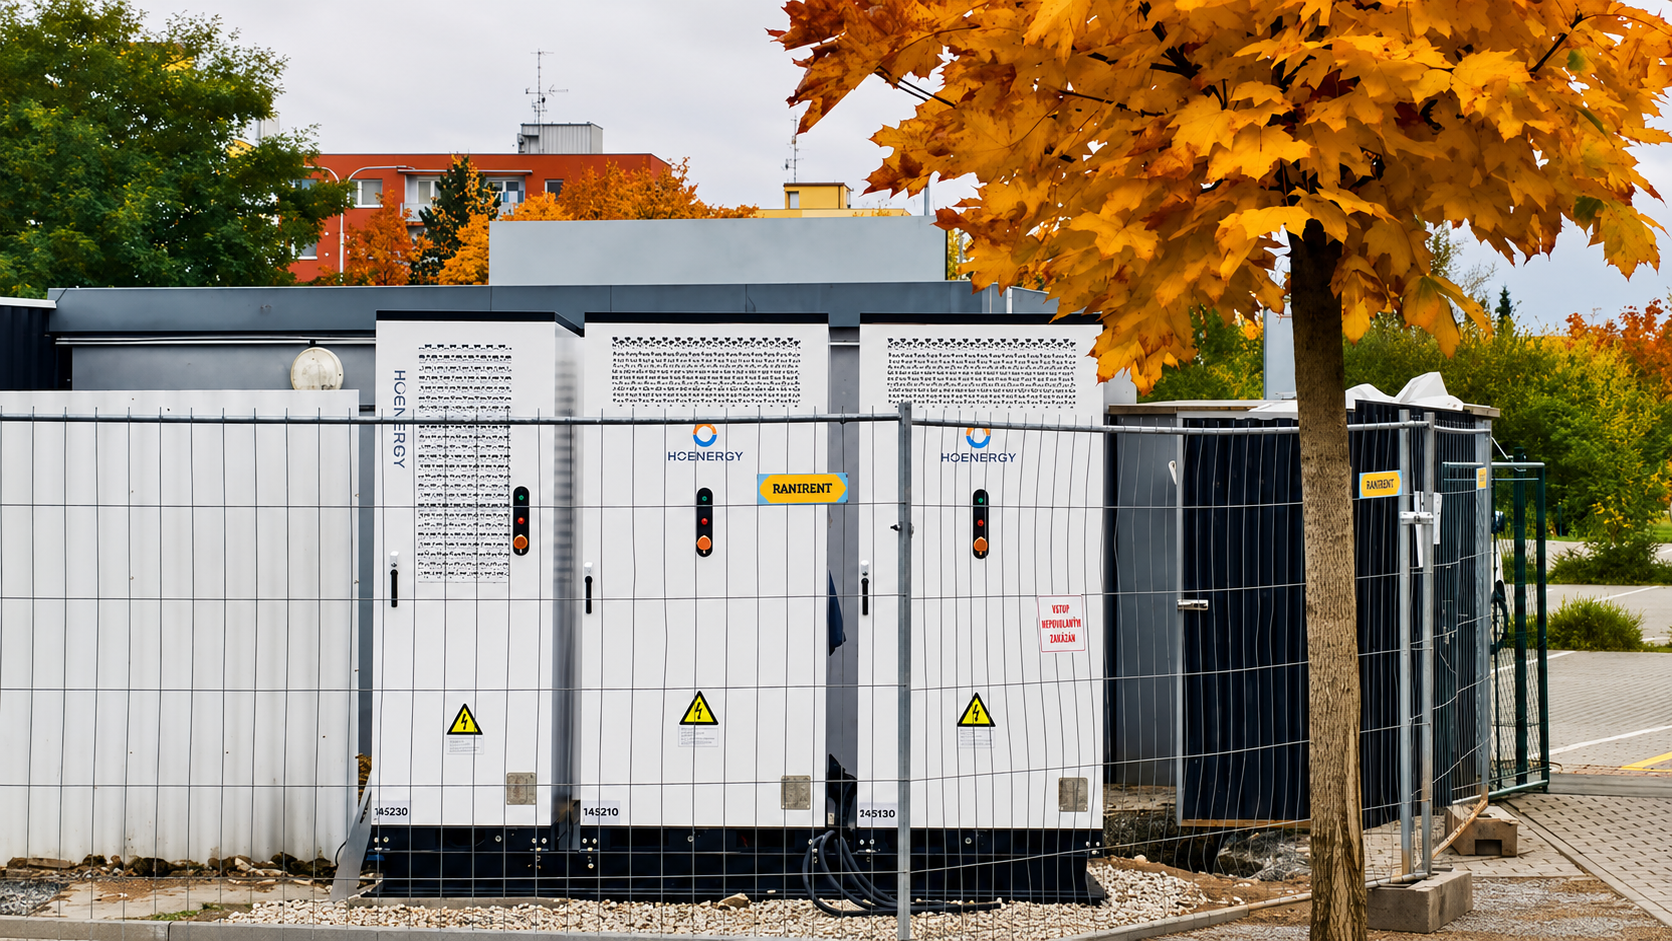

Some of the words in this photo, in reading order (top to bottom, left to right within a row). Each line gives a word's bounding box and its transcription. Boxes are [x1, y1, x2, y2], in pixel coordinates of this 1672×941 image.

[667, 451, 744, 462] HOENERGY
[941, 452, 1017, 463] HOENERGY
[772, 483, 833, 495] RANIRENT
[1051, 604, 1070, 614] VSTOP
[374, 807, 409, 816] 145230
[583, 807, 619, 816] 145210
[859, 809, 896, 818] 245130
